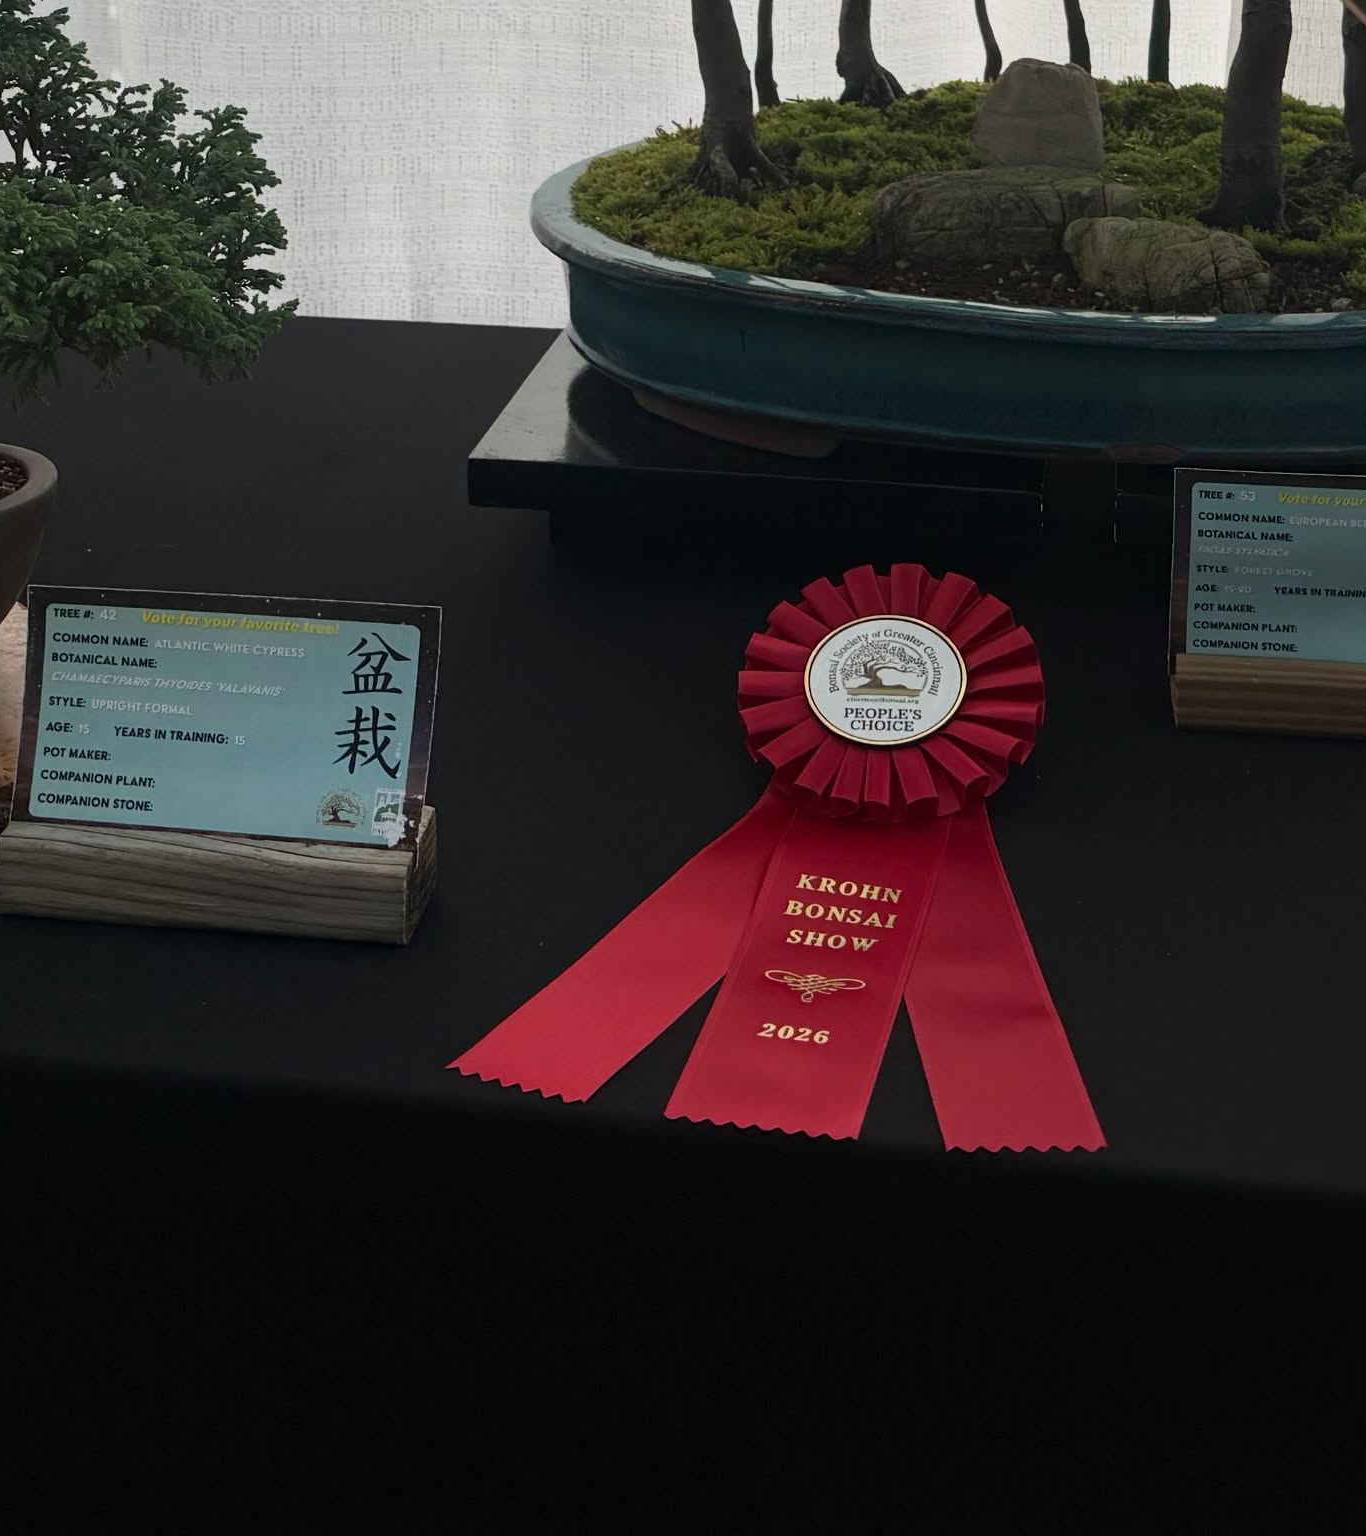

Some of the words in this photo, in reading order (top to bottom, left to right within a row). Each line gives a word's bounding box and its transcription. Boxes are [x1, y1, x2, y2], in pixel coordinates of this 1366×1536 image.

[1199, 490, 1223, 500] TREE
[1240, 490, 1256, 501] 53
[1278, 492, 1308, 504] Vote
[1311, 493, 1330, 505] for
[1333, 495, 1364, 508] your
[1198, 512, 1250, 523] COMMON
[1252, 515, 1285, 524] NAME:
[1289, 516, 1348, 528] EUROPEAN
[1197, 529, 1258, 541] BOTANICAL
[1260, 532, 1294, 542] NAME:
[1196, 564, 1229, 574] STYLE:
[1234, 566, 1274, 576] FOREST
[1195, 584, 1219, 593] AGE:
[1274, 586, 1307, 596] YEARS
[1310, 588, 1322, 596] IN
[53, 608, 80, 619] TREE
[83, 609, 94, 620] #:
[99, 608, 117, 621] 42
[1194, 602, 1214, 611] POT
[1217, 604, 1255, 613] MAKER:
[141, 610, 174, 624] Vote
[178, 613, 199, 625] for
[202, 616, 236, 631] your
[240, 618, 300, 633] favorite
[302, 621, 340, 635] tree!
[1193, 620, 1259, 632] COMPANION
[1261, 623, 1299, 633] PLANT:
[871, 630, 881, 639] of
[883, 629, 925, 647] Greater
[52, 632, 109, 645] COMMON
[112, 636, 149, 648] NAME:
[154, 639, 210, 652] ATLANTIC
[213, 642, 250, 654] WHITE
[253, 644, 305, 658] CYPRESS
[833, 633, 869, 659] Society
[1192, 639, 1259, 651] COMPANION
[1261, 642, 1299, 653] STONE:
[51, 652, 118, 666] BOTANICAL
[121, 656, 157, 669] NAME:
[51, 671, 151, 688] CHAMAECYPARIS
[154, 677, 212, 692] THYOIDES
[828, 659, 840, 694] Bonsai
[48, 695, 86, 708] STYLE:
[91, 699, 141, 712] UPRIGHT
[145, 702, 193, 716] FORMAL
[332, 632, 412, 780] 盆栽
[843, 707, 922, 720] PEOPLE'S
[45, 721, 73, 733] AGE:
[78, 723, 90, 734] 15
[850, 719, 915, 732] CHOICE
[114, 725, 151, 739] YEARS
[154, 729, 167, 740] IN
[170, 730, 229, 745] TRAINING:
[234, 735, 246, 746] 15
[43, 746, 66, 758] POT
[68, 749, 111, 761] MAKER:
[40, 769, 113, 785] COMPANION
[115, 775, 156, 788] PLANT:
[37, 792, 110, 808] COMPANION
[112, 798, 153, 812] STONE:
[795, 873, 904, 904] KROHN
[783, 900, 898, 929] BONSAI
[786, 929, 879, 952] SHOW
[756, 1022, 831, 1044] 2026
